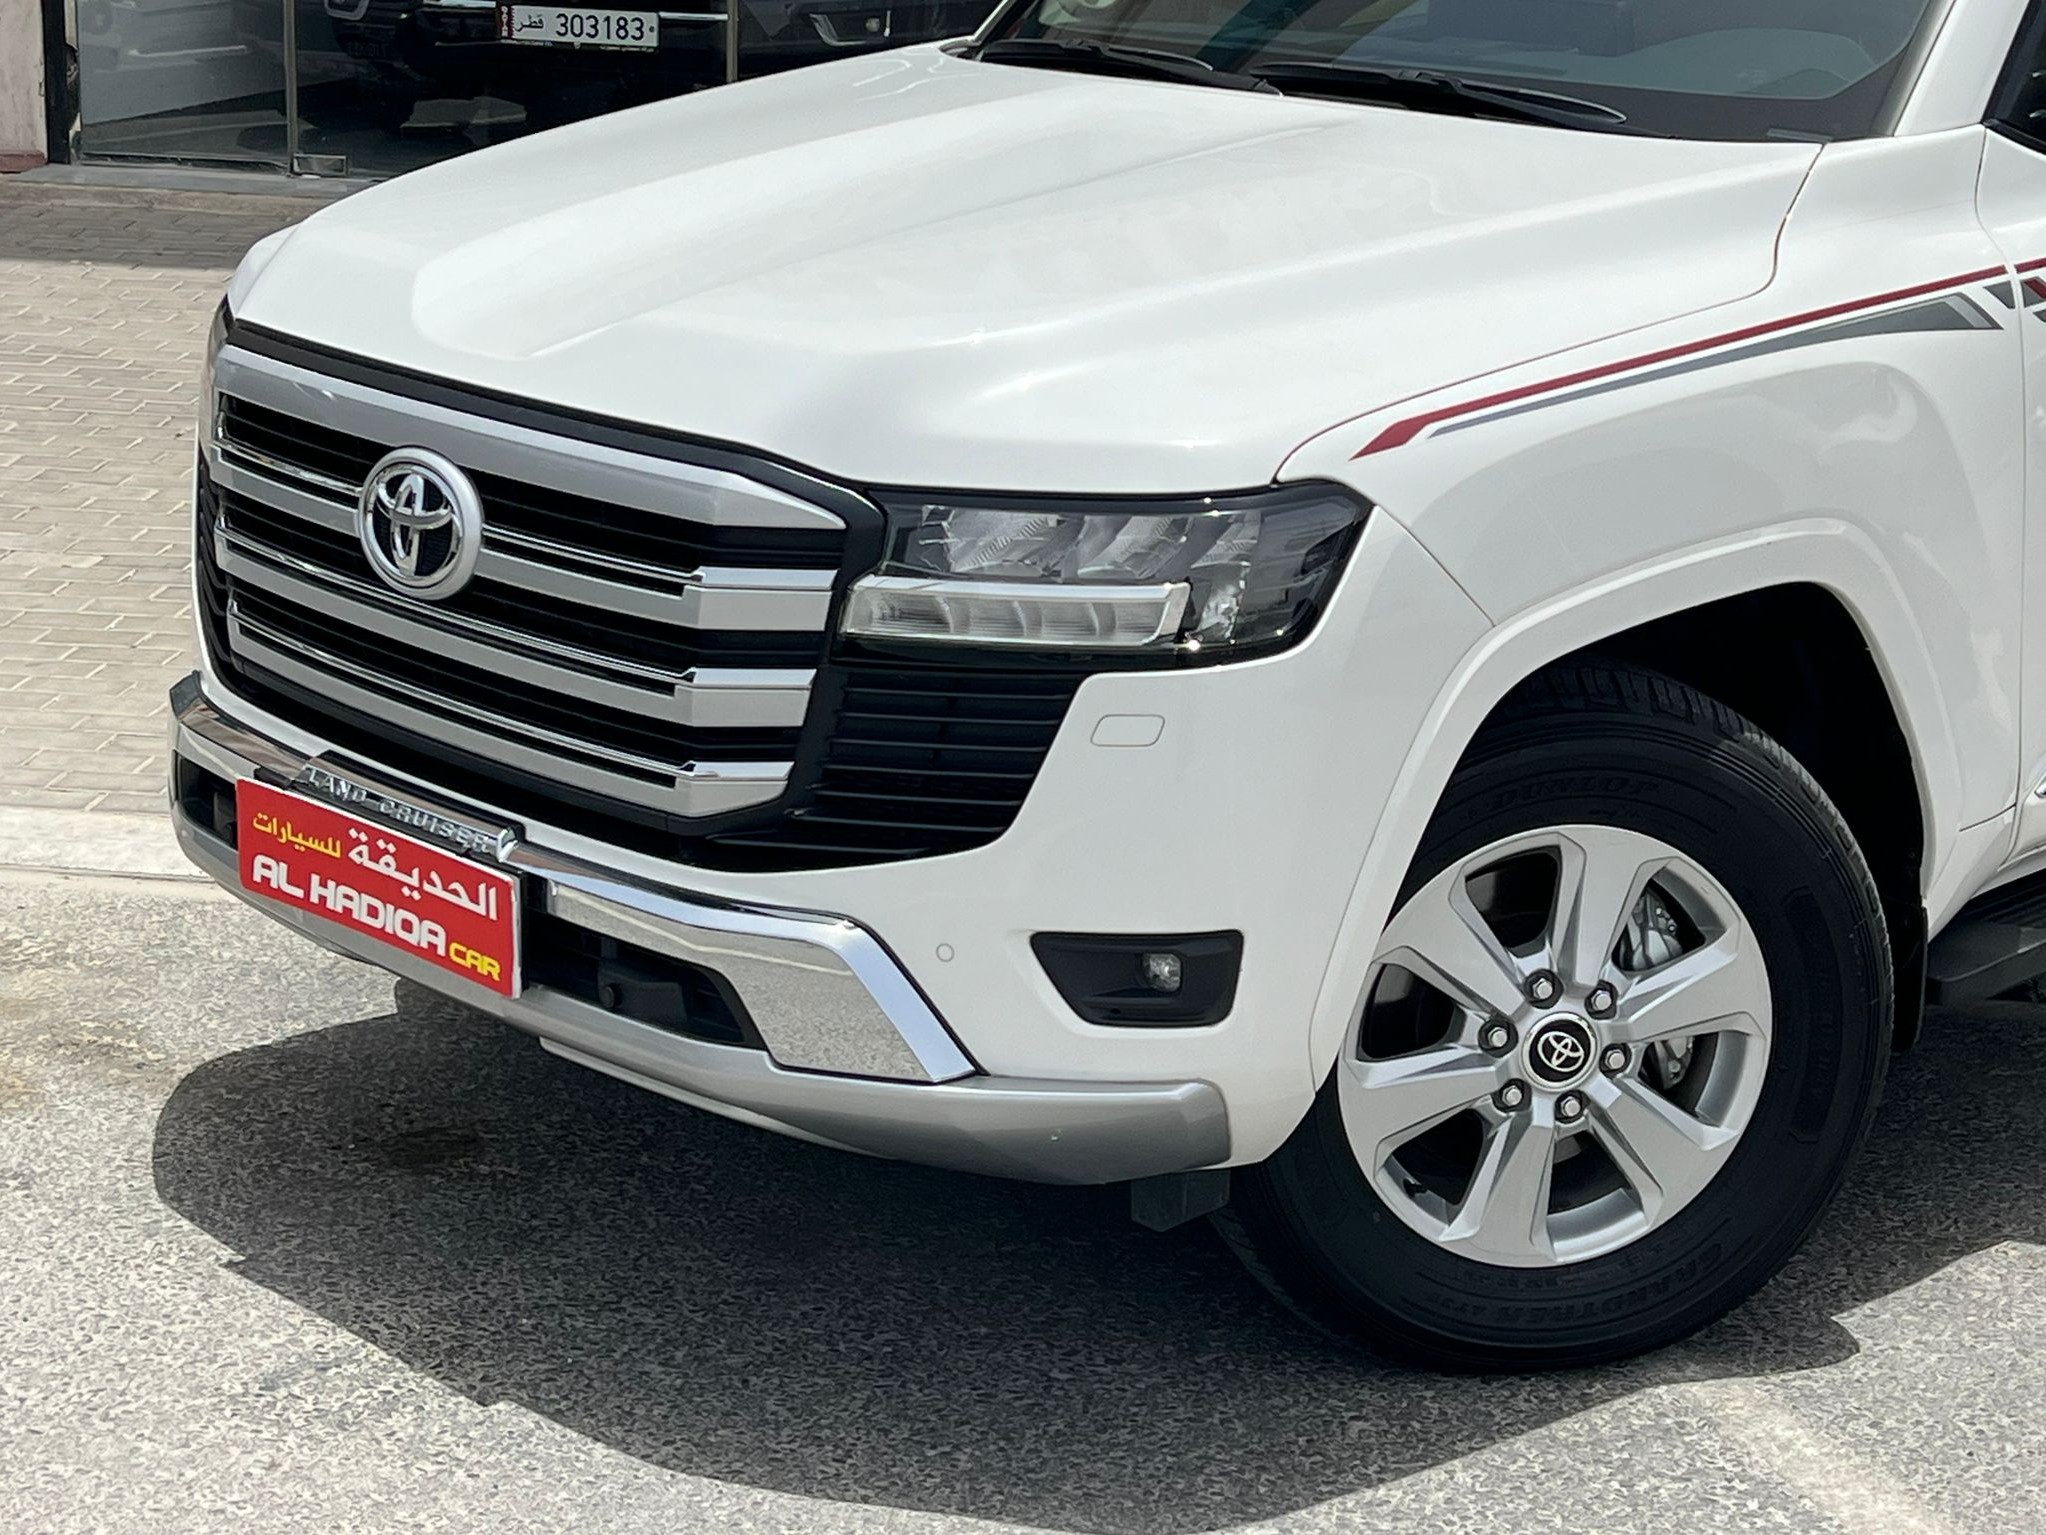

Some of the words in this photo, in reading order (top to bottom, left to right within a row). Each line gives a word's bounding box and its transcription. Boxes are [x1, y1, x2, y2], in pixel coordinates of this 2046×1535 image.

[515, 14, 545, 32] قطر
[555, 13, 645, 41] 303183
[252, 812, 342, 859] للسيارات
[308, 768, 367, 802] LAND
[379, 799, 490, 853] CRUISER
[348, 827, 498, 921] الحديقة
[252, 854, 304, 900] AL
[309, 873, 447, 957] HADIQA
[449, 941, 501, 982] CAR
